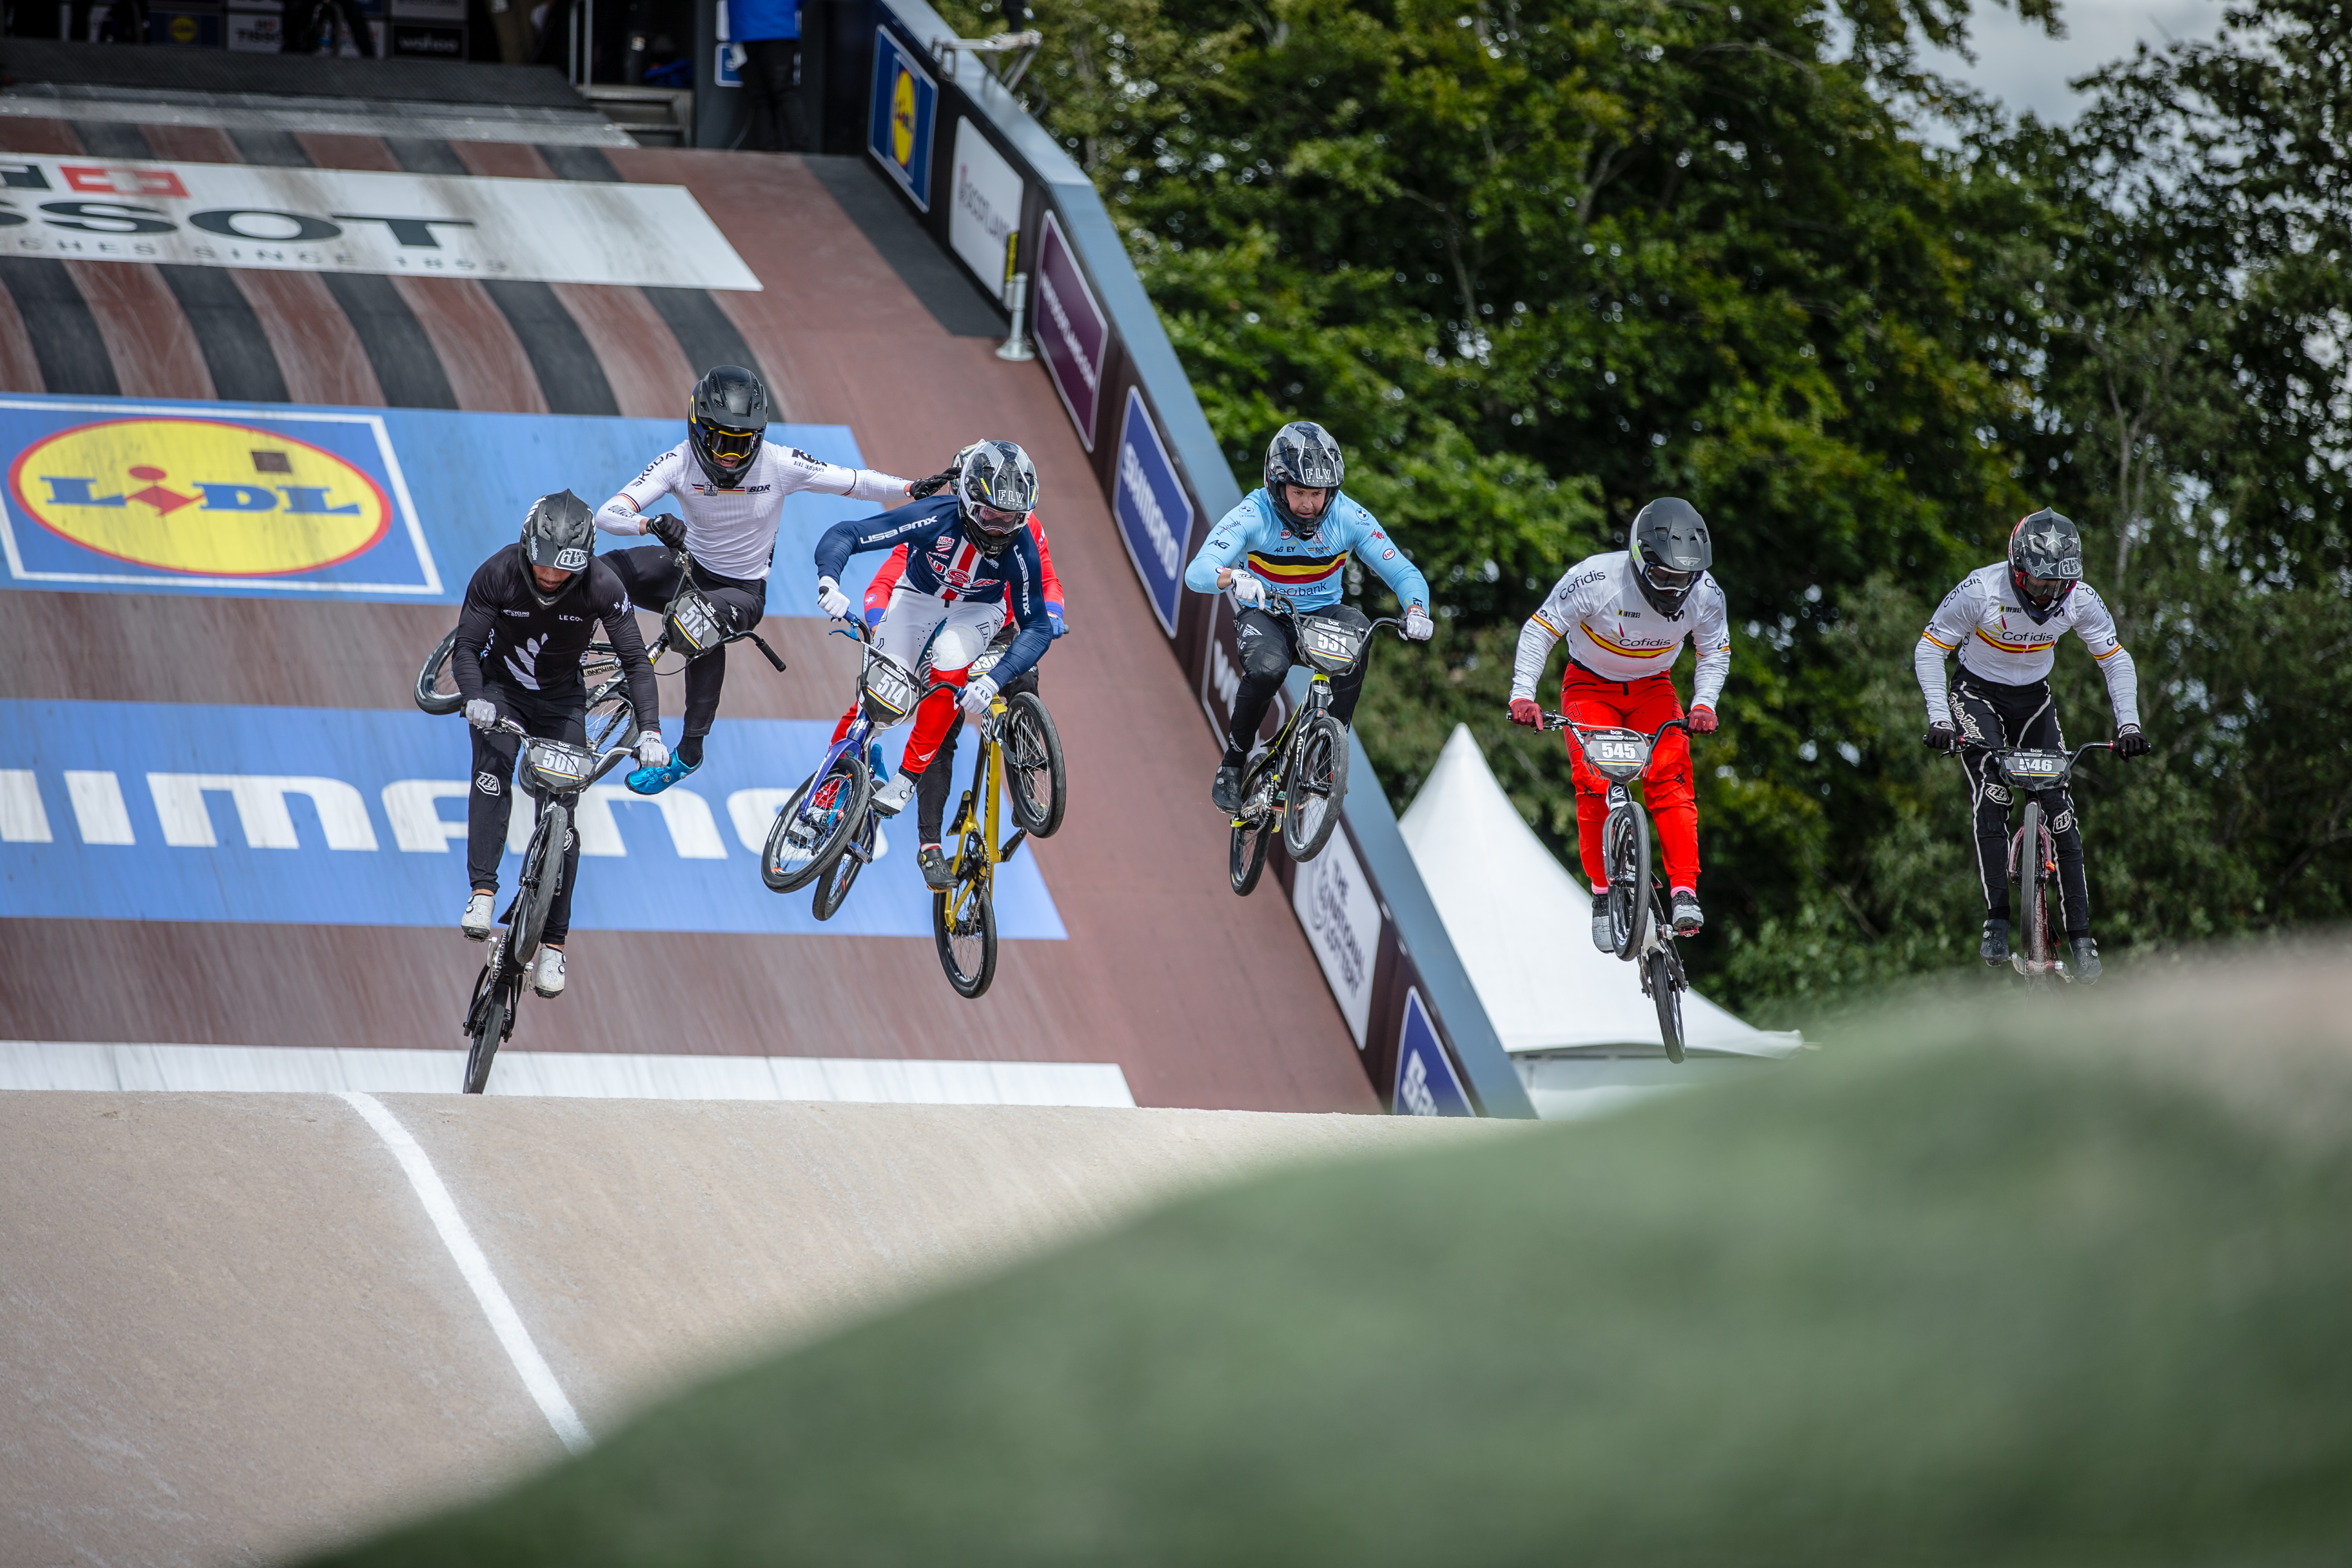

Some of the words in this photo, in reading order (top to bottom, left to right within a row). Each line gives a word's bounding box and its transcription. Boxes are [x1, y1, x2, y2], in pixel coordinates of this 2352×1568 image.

[1305, 468, 1331, 480] FLY
[750, 484, 771, 493] BDR
[998, 490, 1024, 504] FLY
[1121, 441, 1179, 581] SHIMANO
[859, 529, 899, 544] USA
[898, 515, 938, 534] BMX
[926, 552, 1000, 587] USA
[1270, 582, 1327, 597] beobank
[1559, 570, 1606, 600] Cofidis
[706, 602, 717, 614] box
[681, 603, 711, 639] 513
[1328, 618, 1339, 627] box
[1318, 632, 1347, 654] 531
[1619, 638, 1671, 647] Cofidis
[2001, 631, 2053, 641] Cofidis
[876, 673, 908, 706] 514
[974, 685, 990, 701] FLY
[1602, 742, 1636, 759] 545
[542, 750, 579, 774] 500
[2019, 758, 2053, 772] 546
